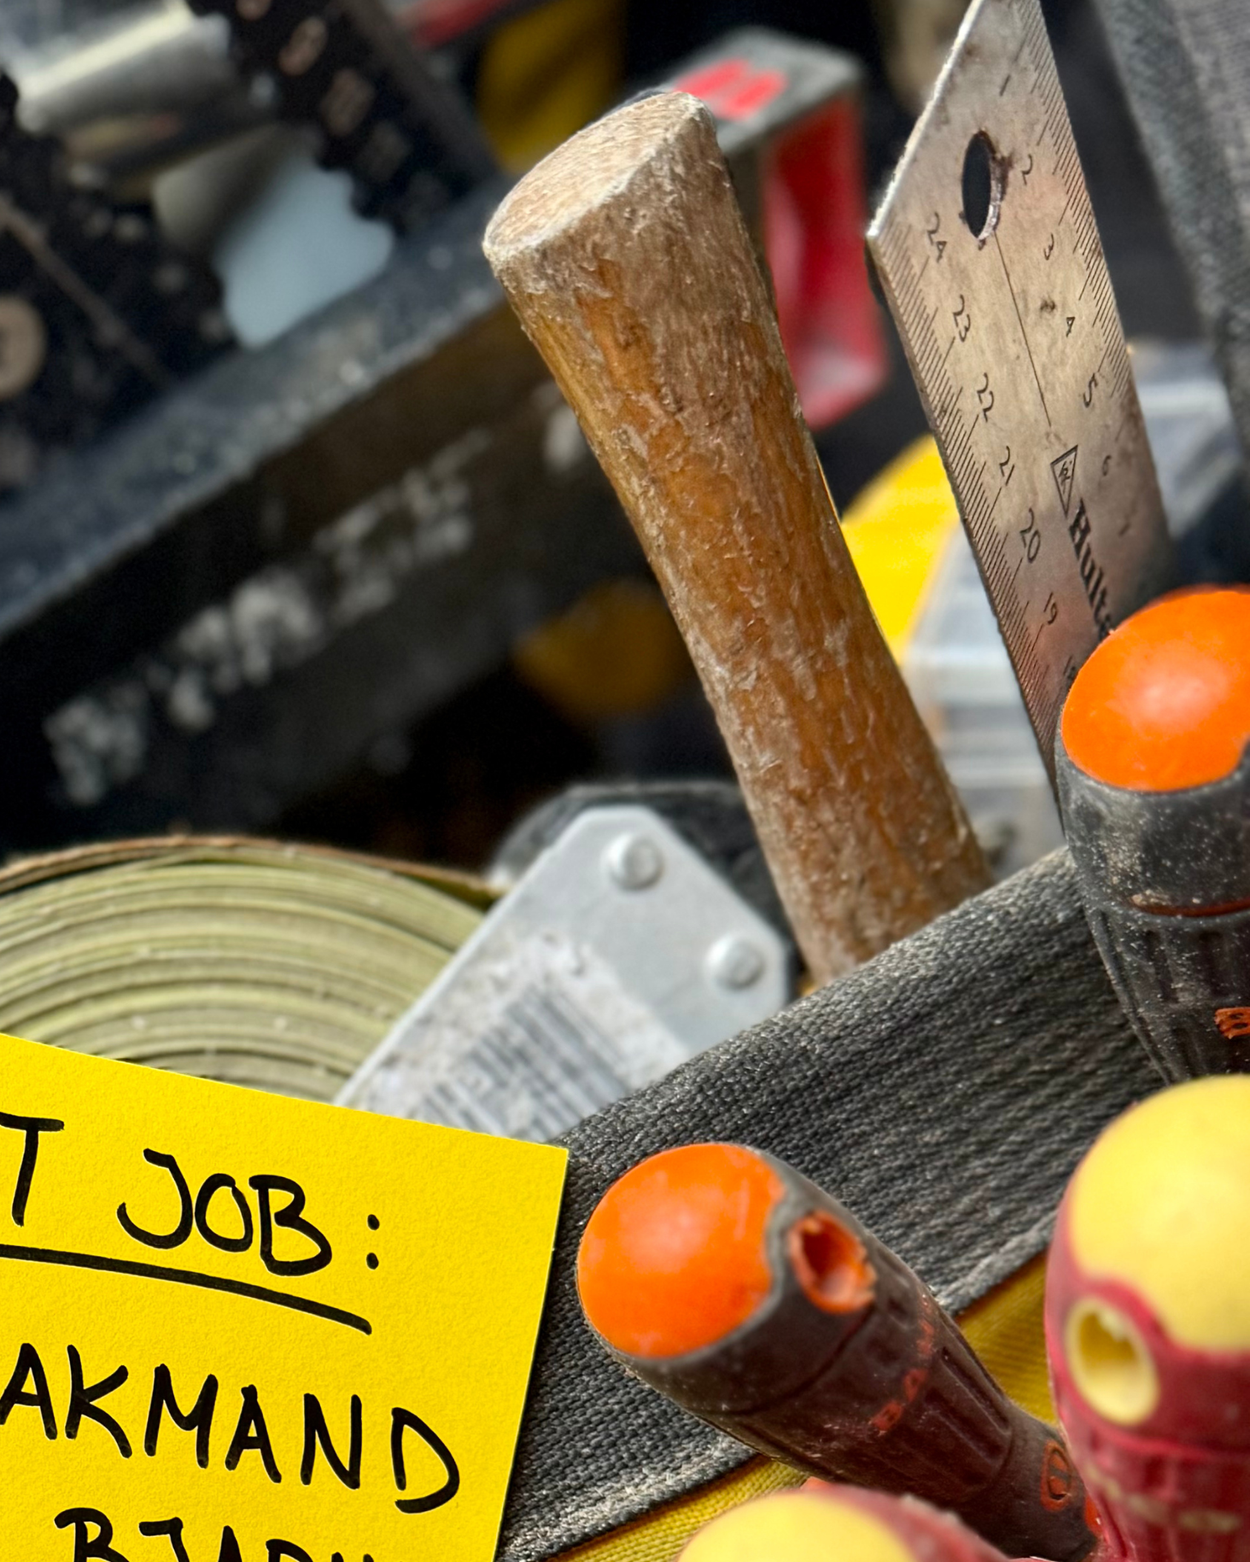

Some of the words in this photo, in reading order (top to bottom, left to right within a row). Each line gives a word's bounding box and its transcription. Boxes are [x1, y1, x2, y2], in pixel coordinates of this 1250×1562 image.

[927, 211, 948, 264] 24
[953, 293, 972, 343] 23
[977, 371, 995, 423] 22
[998, 445, 1016, 487] 21
[1019, 507, 1042, 564] 20
[1043, 591, 1058, 626] 19
[1021, 153, 1033, 186] 2
[1043, 233, 1055, 261] 3
[1065, 316, 1076, 338] 4
[1082, 372, 1099, 409] 5
